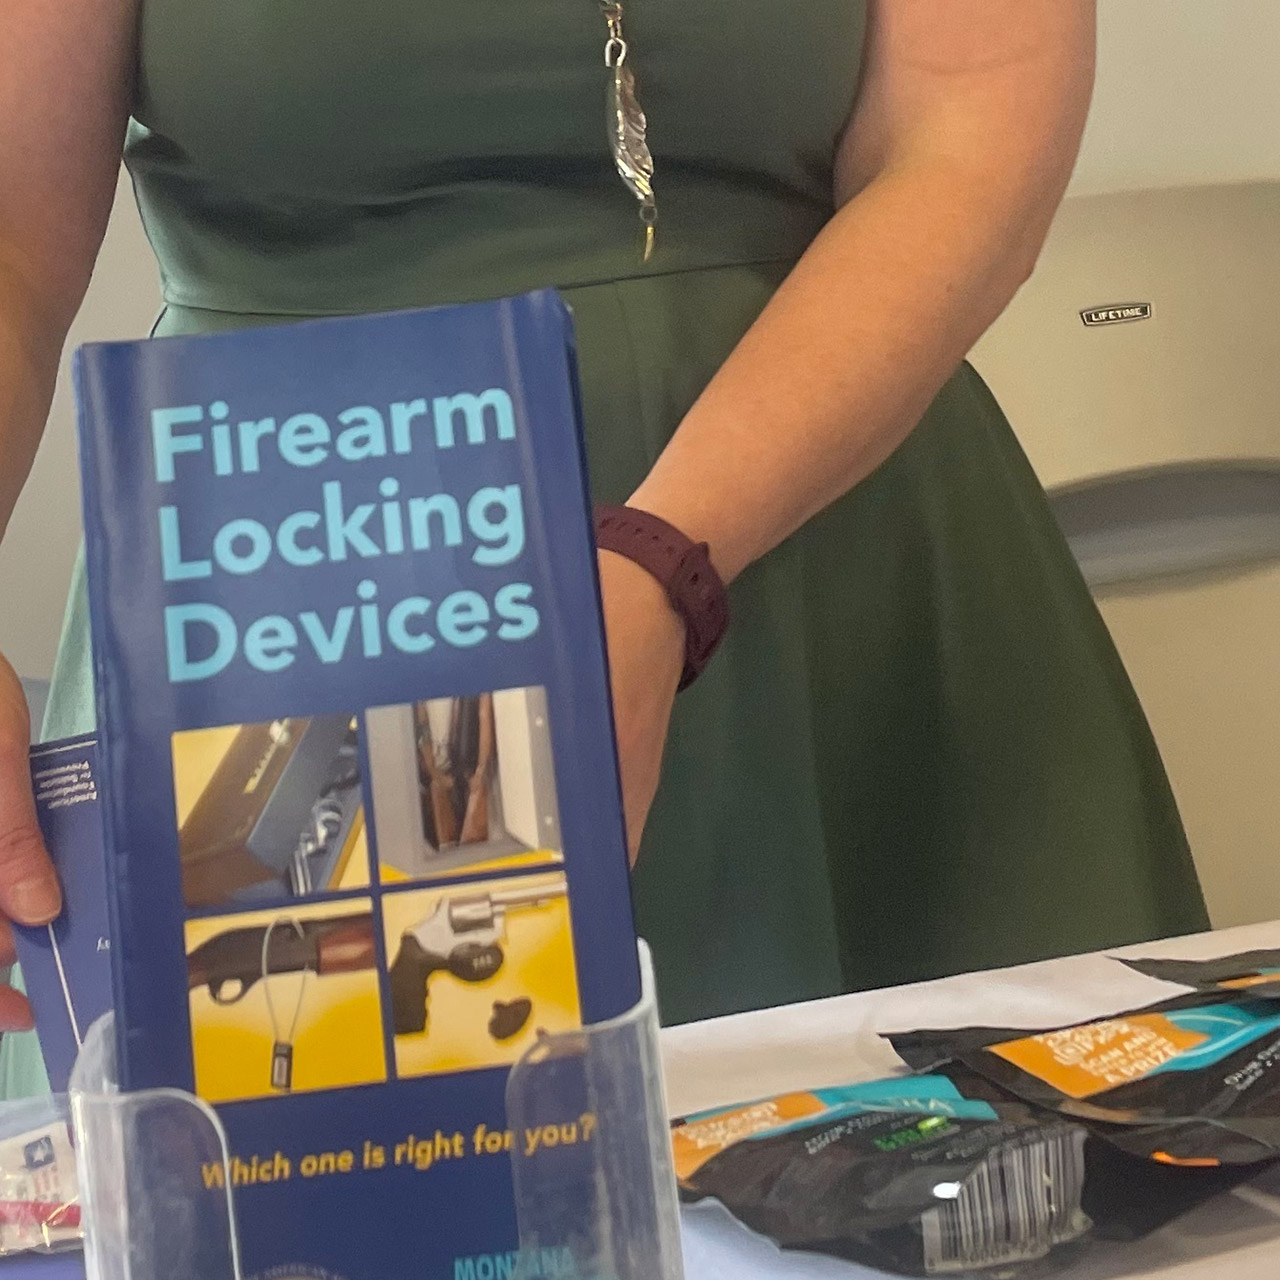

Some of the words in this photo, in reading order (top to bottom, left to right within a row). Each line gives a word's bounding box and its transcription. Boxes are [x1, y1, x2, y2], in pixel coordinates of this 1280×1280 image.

[1091, 307, 1143, 322] LIFETIME
[150, 386, 517, 483] Firearm
[158, 477, 527, 582] Locking
[164, 579, 541, 683] Devices
[200, 1151, 291, 1190] Which
[299, 1148, 354, 1179] one
[362, 1140, 386, 1170] is
[393, 1129, 464, 1171] right
[473, 1123, 516, 1156] for
[524, 1111, 599, 1157] you?
